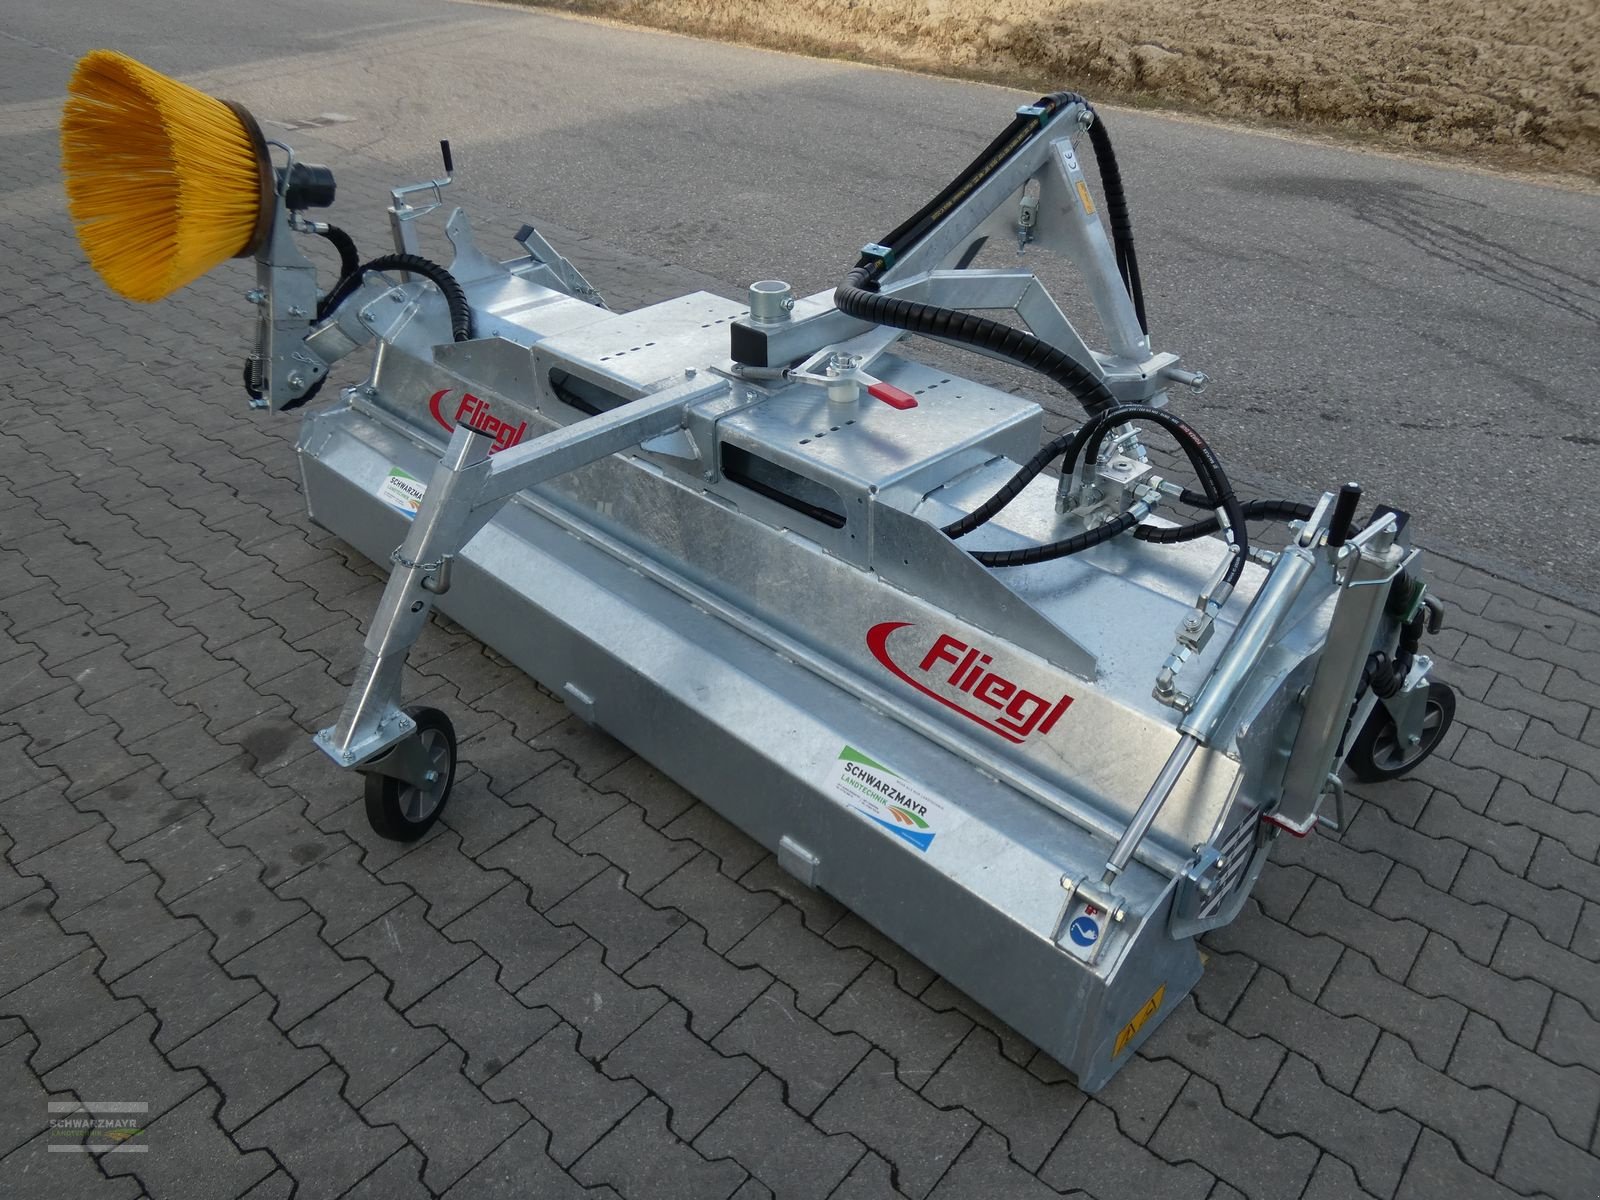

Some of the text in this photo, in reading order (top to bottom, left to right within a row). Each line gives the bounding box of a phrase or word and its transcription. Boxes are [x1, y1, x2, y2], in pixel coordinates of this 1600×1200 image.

[455, 393, 527, 451] Fliegl
[919, 634, 1075, 736] Fliegl
[841, 774, 889, 806] LANDTECHNIK
[844, 762, 928, 817] SCHWARZMAYR
